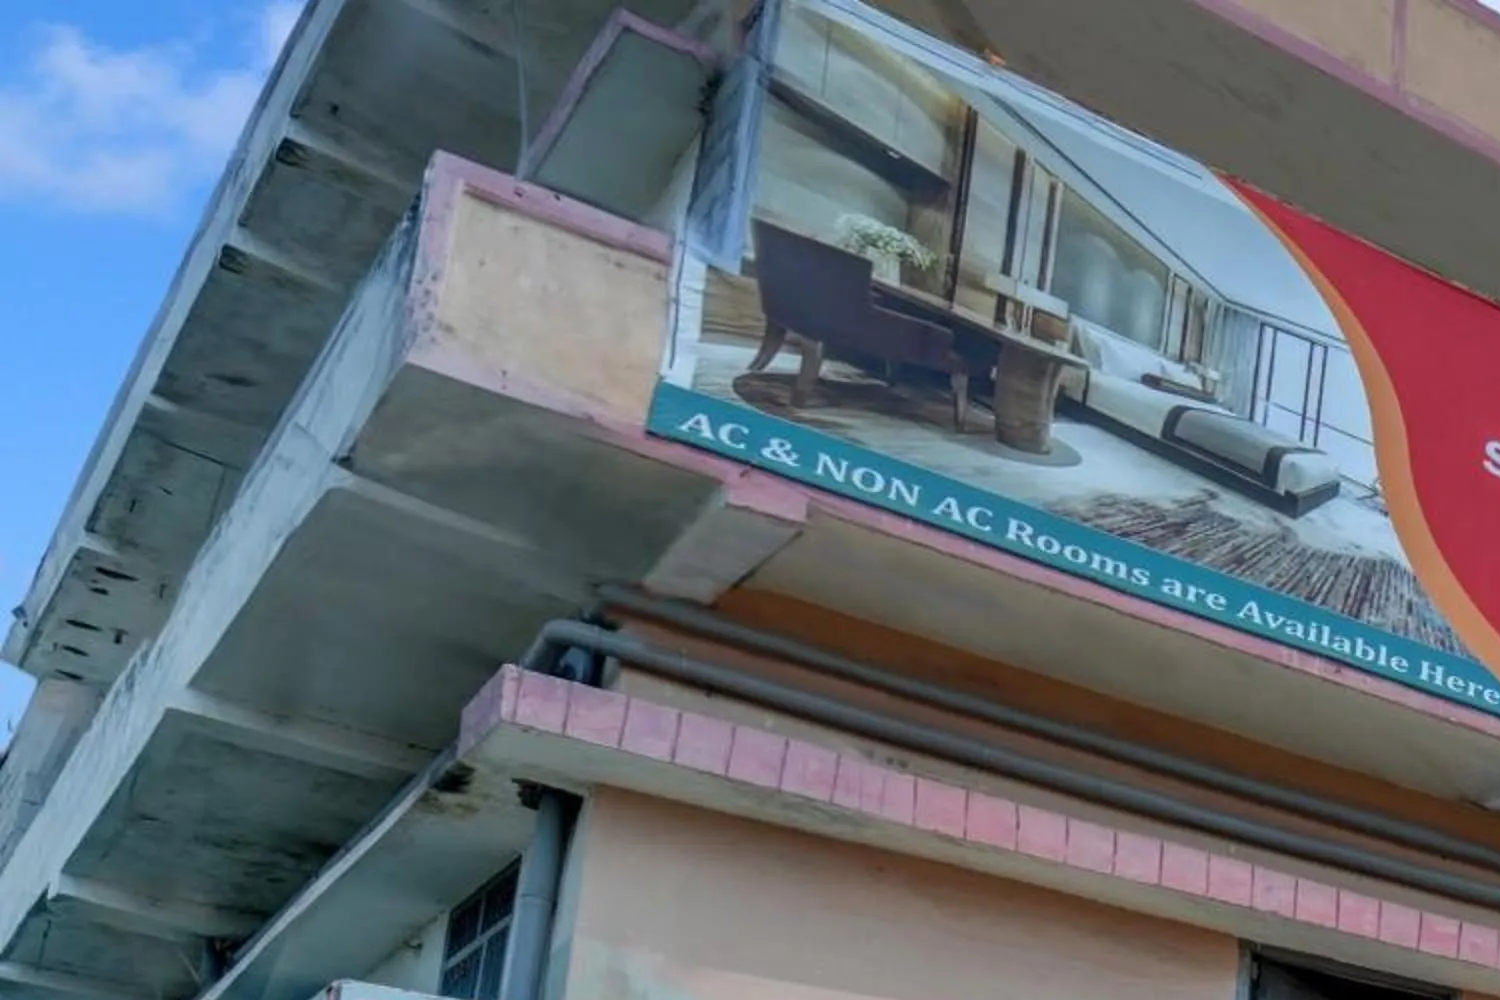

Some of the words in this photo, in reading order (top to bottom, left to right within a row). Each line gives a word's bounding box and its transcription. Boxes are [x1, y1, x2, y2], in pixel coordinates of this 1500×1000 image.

[679, 410, 751, 457] AC
[761, 436, 801, 468] &
[814, 452, 922, 508] NON
[932, 496, 994, 534] AC
[1006, 516, 1150, 588] Rooms
[1160, 577, 1228, 612] are
[1238, 598, 1410, 675] Available
